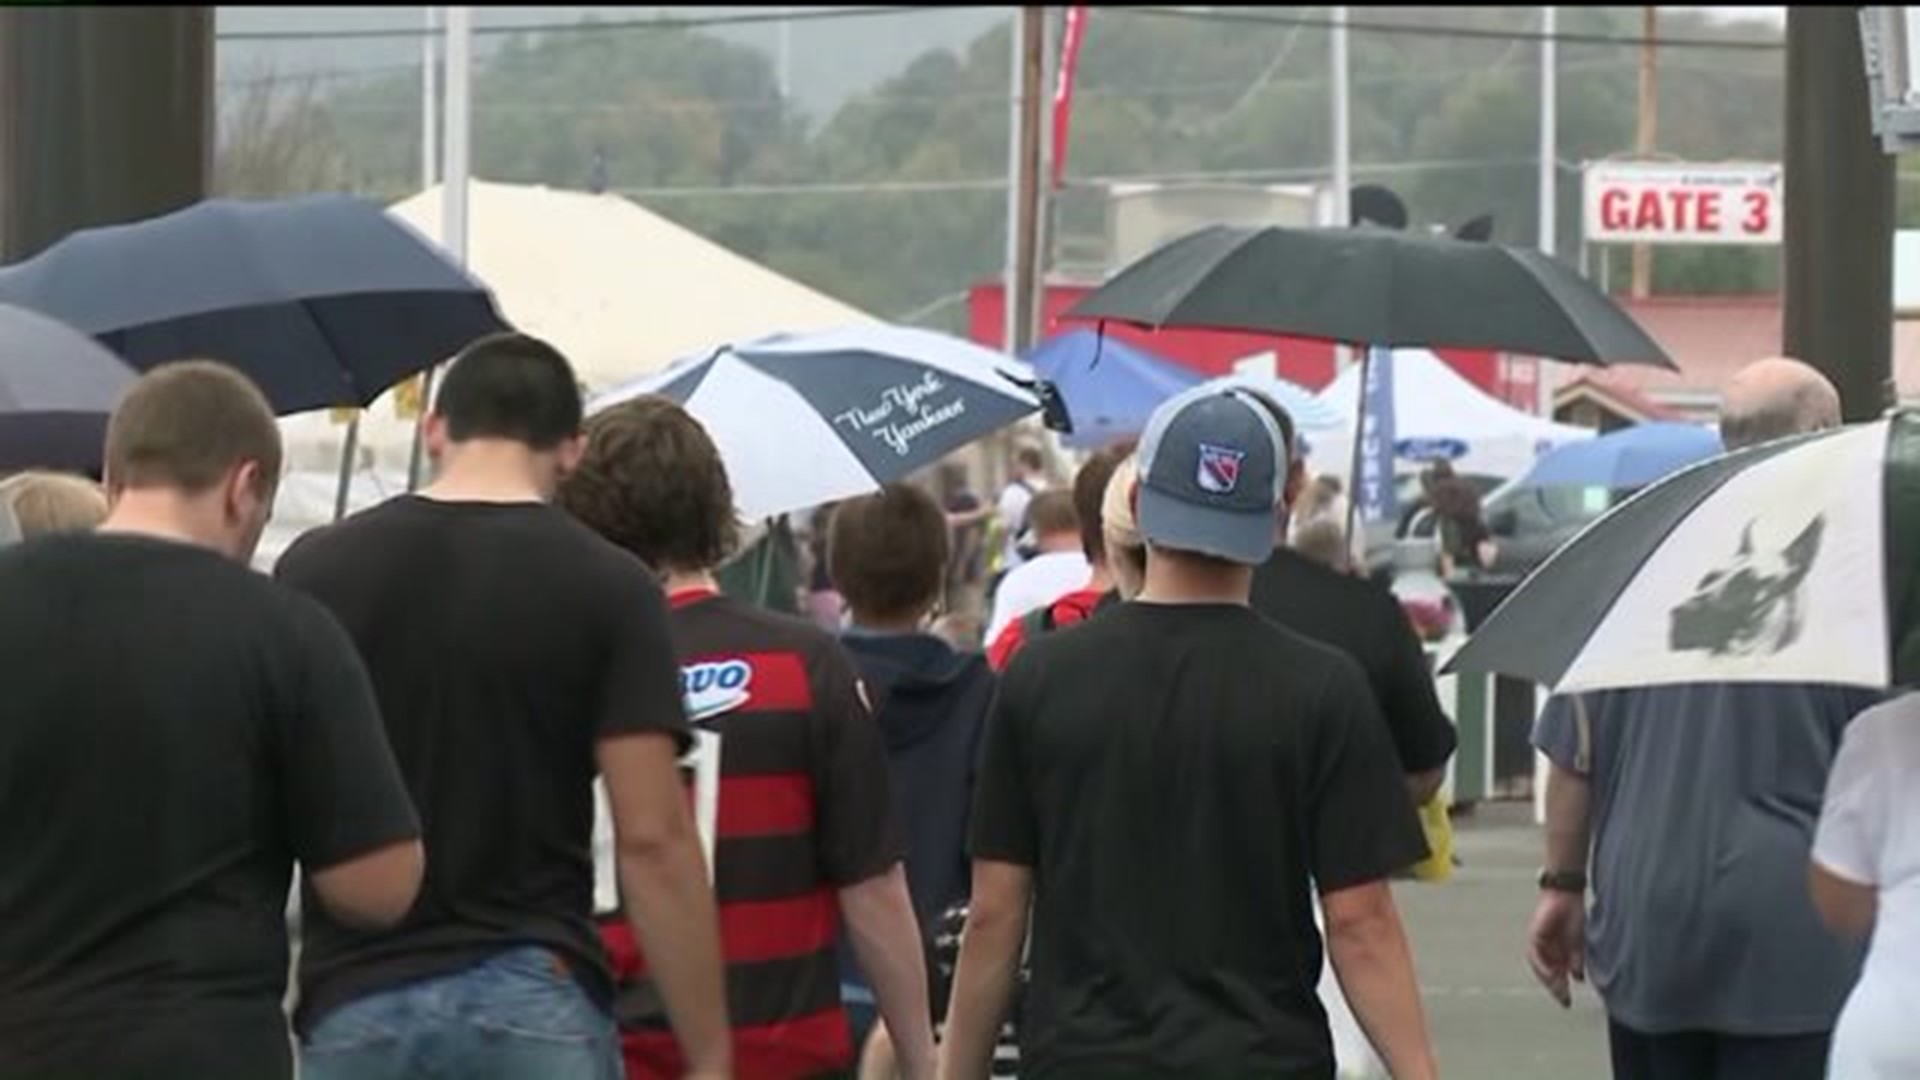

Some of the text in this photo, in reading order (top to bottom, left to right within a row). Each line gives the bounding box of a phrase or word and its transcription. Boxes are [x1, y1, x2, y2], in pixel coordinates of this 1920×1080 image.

[1600, 191, 1770, 233] GATE 3
[833, 370, 945, 431] New York
[872, 398, 965, 457] Yankees
